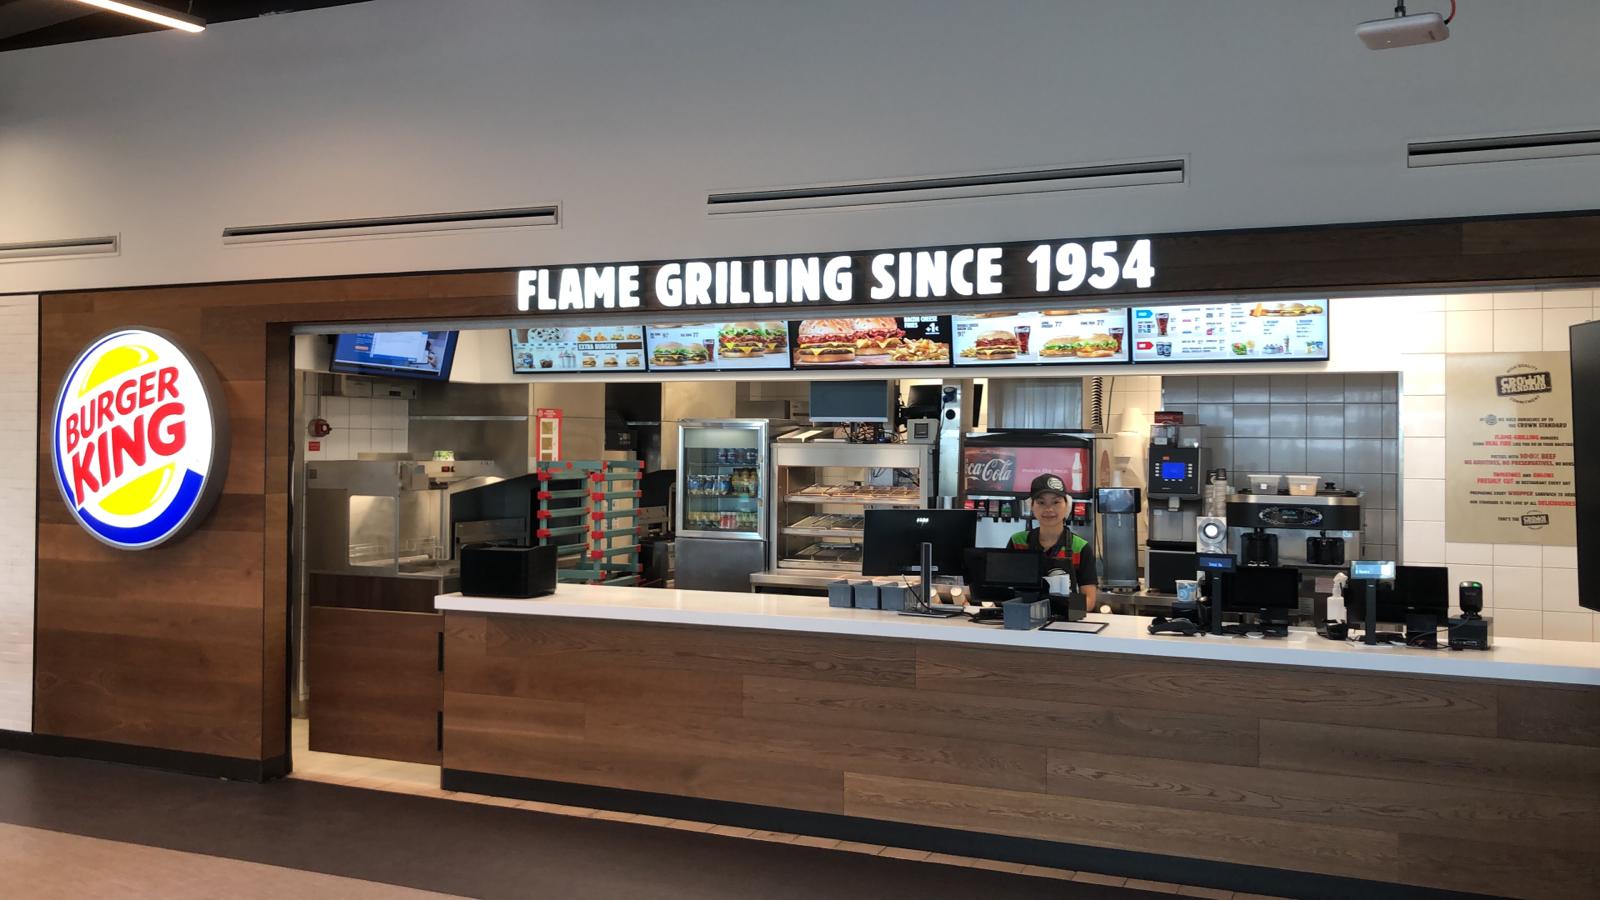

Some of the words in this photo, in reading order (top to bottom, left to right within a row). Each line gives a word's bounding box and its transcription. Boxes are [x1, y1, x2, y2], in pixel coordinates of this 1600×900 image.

[517, 265, 641, 311] FLAME
[655, 255, 853, 307] GRILLING
[870, 247, 1003, 300] SINCE
[1026, 238, 1156, 292] 1954
[66, 366, 180, 455] BURGER
[1500, 374, 1546, 388] CROWN
[72, 402, 187, 507] KING
